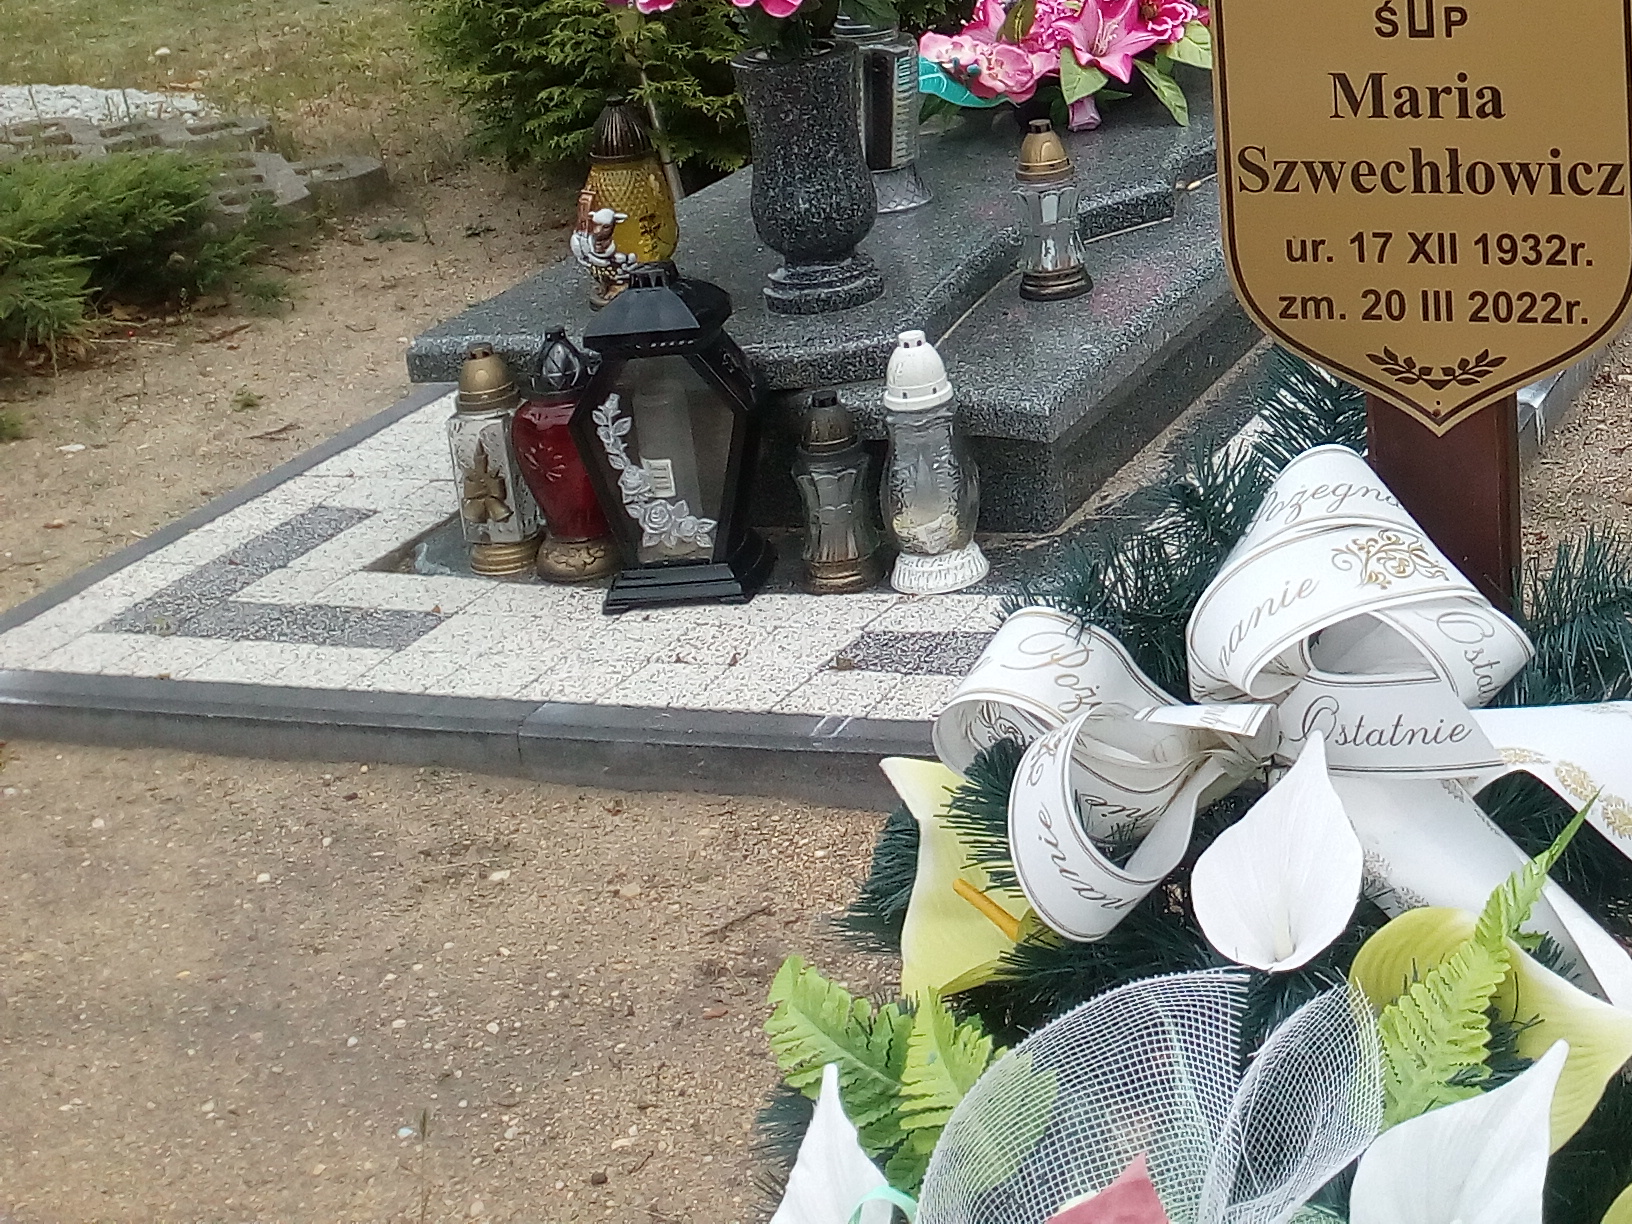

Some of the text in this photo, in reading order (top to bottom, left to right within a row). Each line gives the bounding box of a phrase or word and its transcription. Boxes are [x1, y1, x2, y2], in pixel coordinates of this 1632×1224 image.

[1373, 0, 1469, 38] Ś P
[1327, 71, 1507, 121] Maria
[1236, 144, 1627, 199] Szwechłowicz
[1285, 232, 1595, 268] ur. 17 XII 1932r.
[1277, 288, 1590, 325] zm. 20 III 2022r.
[1290, 694, 1473, 747] Ostatnie
